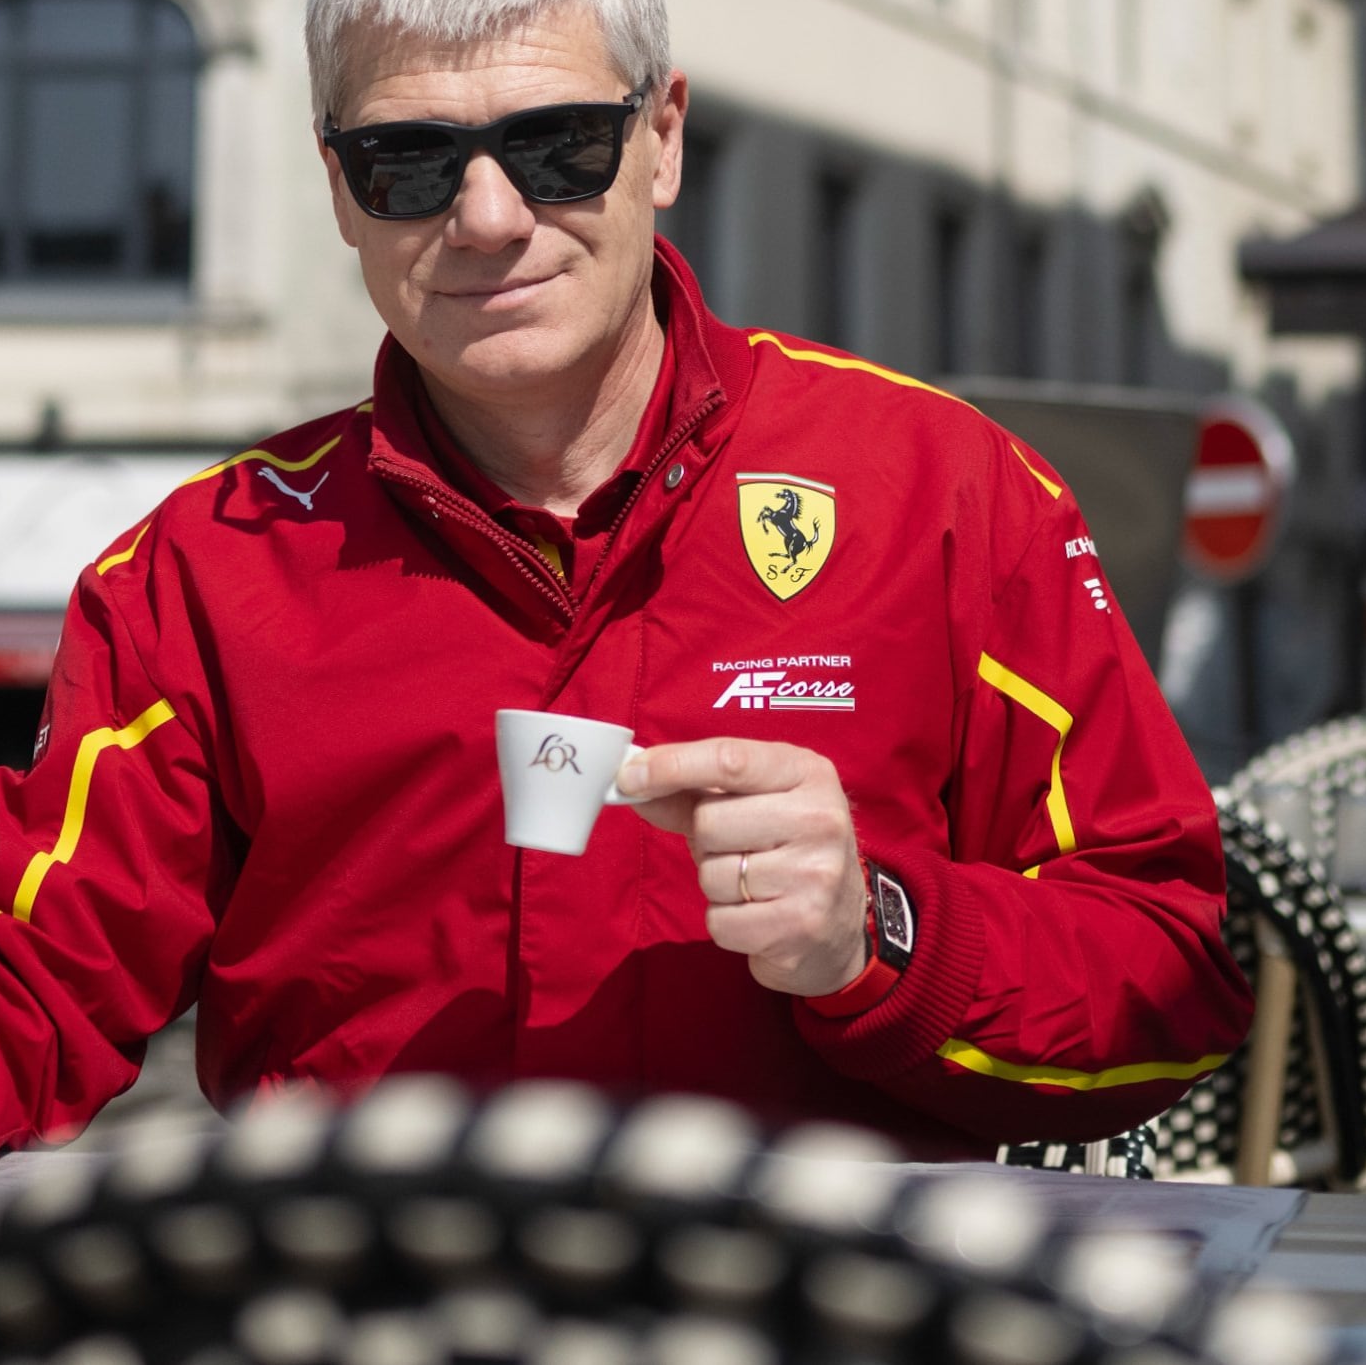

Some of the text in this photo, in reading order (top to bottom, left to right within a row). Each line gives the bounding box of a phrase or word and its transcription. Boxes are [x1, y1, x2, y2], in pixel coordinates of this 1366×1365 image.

[766, 564, 813, 583] S F
[712, 655, 851, 672] RACING PARTNER
